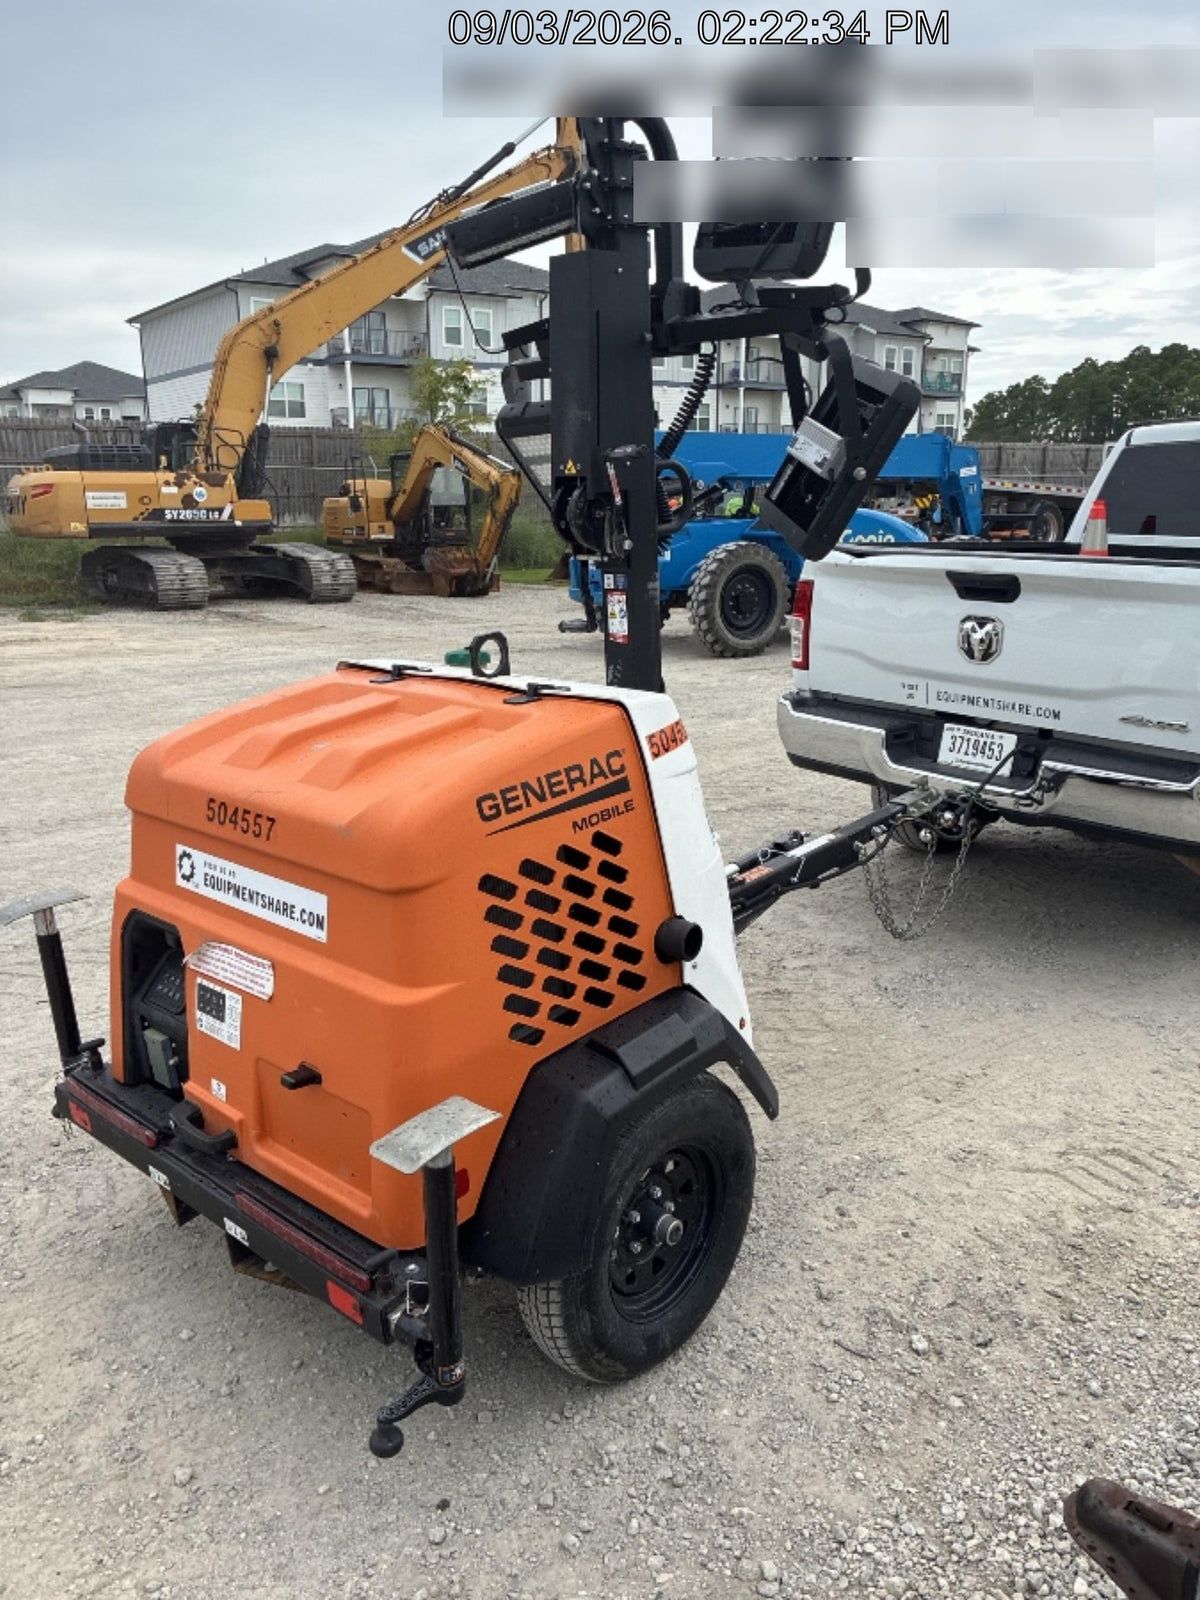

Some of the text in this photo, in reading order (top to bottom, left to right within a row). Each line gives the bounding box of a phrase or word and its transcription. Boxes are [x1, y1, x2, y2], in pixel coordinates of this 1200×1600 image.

[936, 690, 1061, 721] EQUIPMENTSHARE.COM
[949, 735, 1004, 762] 3719453
[476, 749, 627, 823] GENERAC
[206, 798, 276, 841] 504557
[571, 799, 635, 833] MOBILE
[203, 872, 325, 932] EQUIPMENTSHARE.COM
